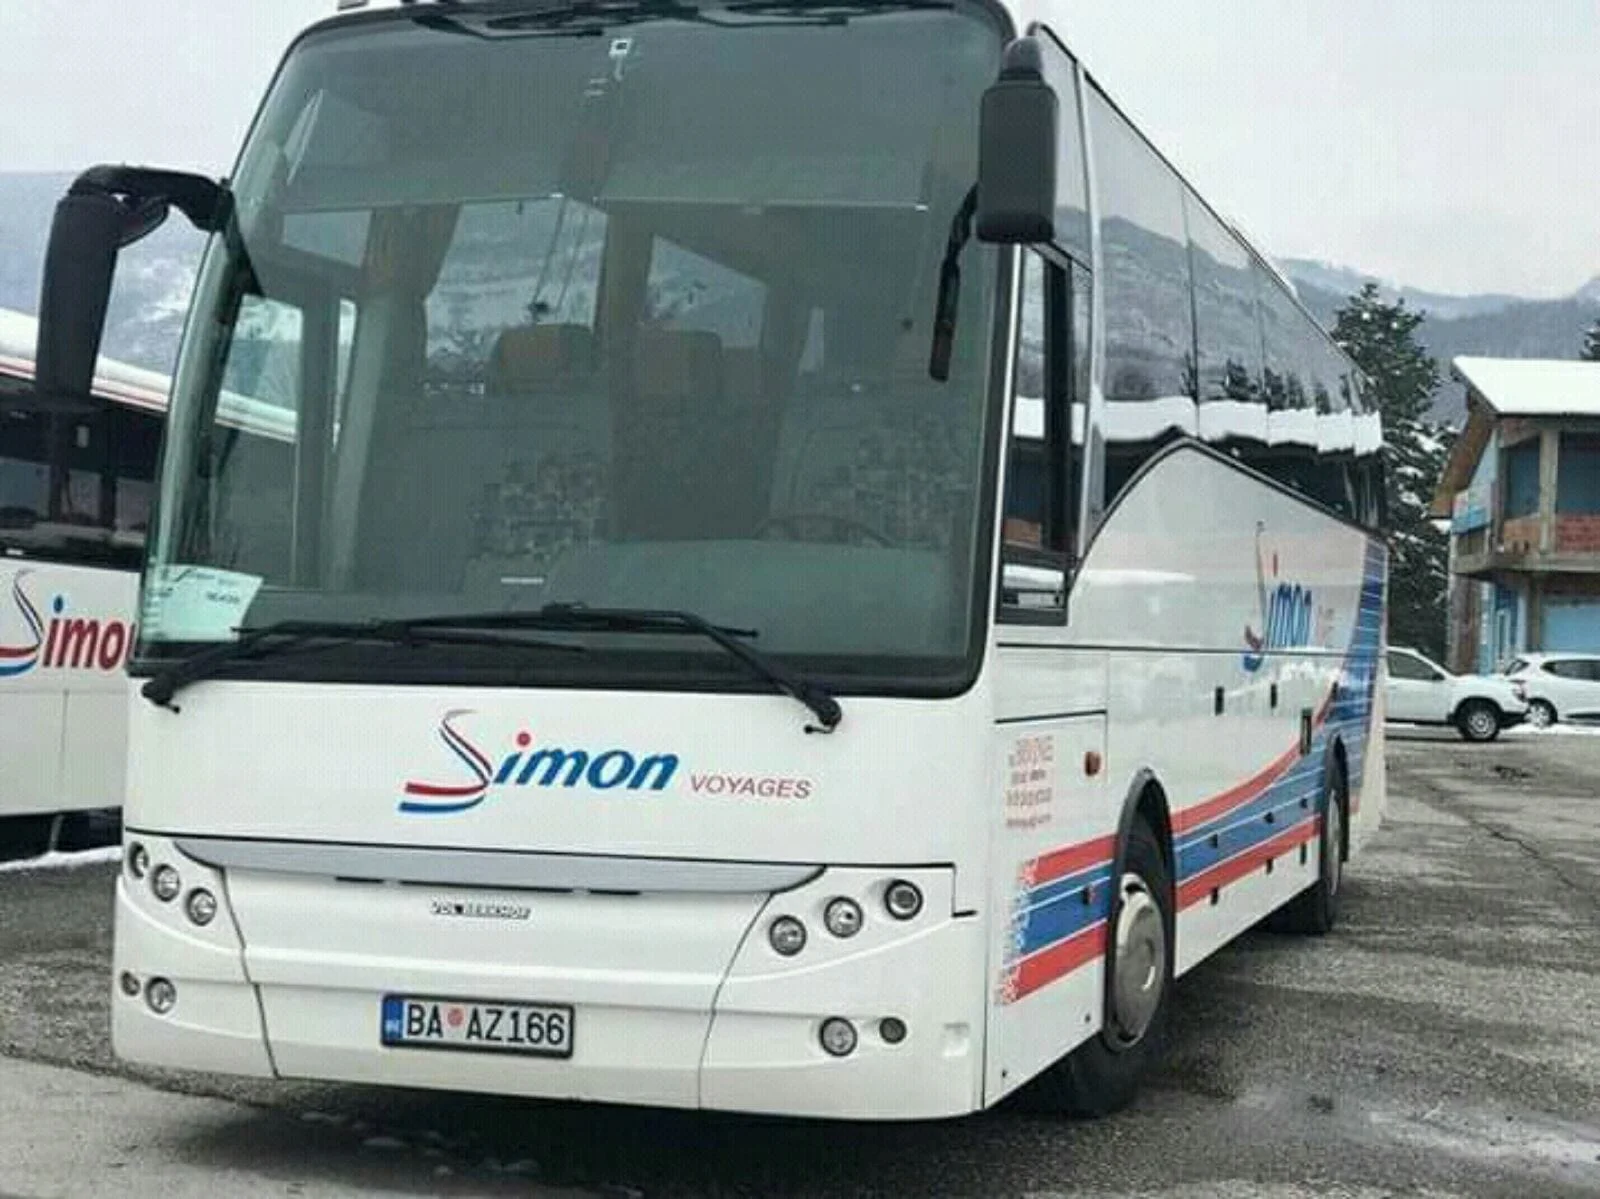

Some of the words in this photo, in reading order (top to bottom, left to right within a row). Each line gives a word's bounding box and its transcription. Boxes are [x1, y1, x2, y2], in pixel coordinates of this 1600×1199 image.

[399, 708, 679, 814] Simon
[690, 774, 812, 800] VOYAGES
[407, 1004, 443, 1038] BA
[466, 1008, 566, 1046] AZ166
